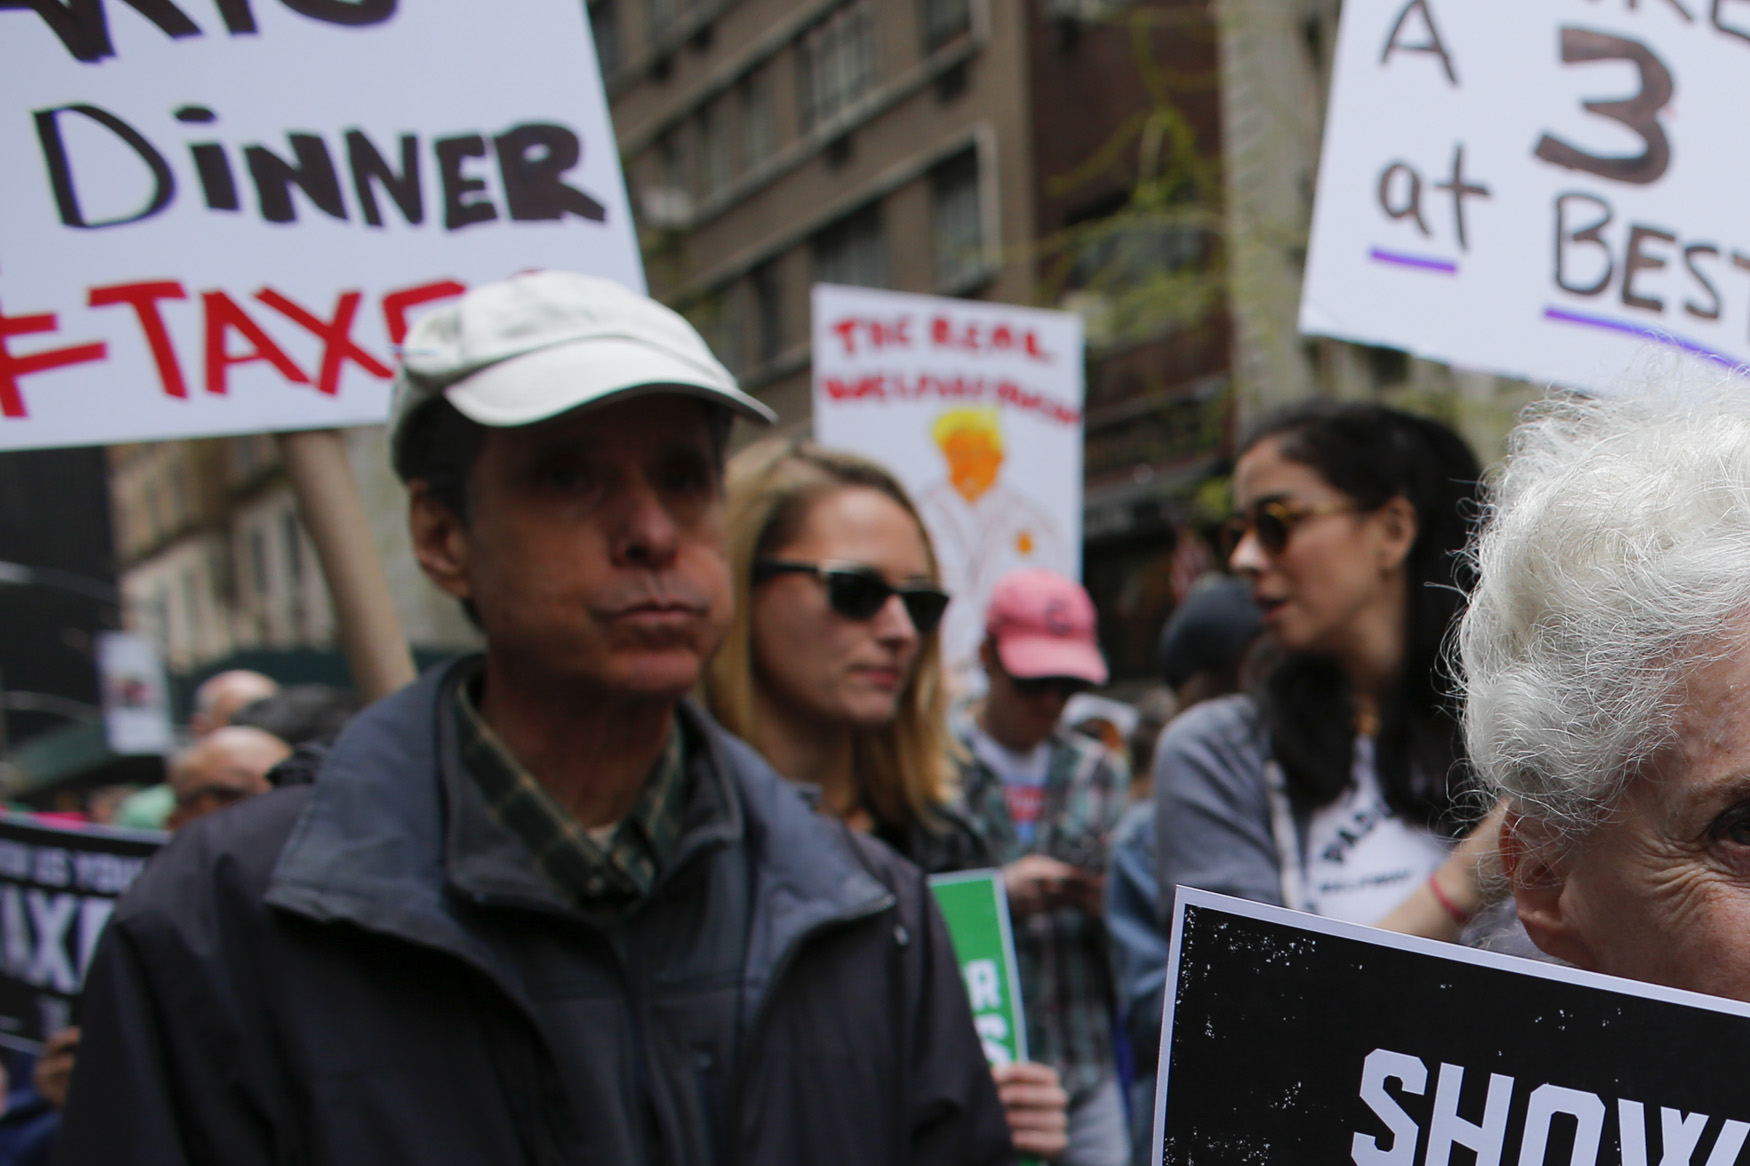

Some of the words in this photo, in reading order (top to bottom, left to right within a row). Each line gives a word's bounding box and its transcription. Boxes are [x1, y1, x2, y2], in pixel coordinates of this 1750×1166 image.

[1379, 0, 1459, 87] A
[1532, 25, 1674, 185] 3
[1376, 142, 1491, 252] at
